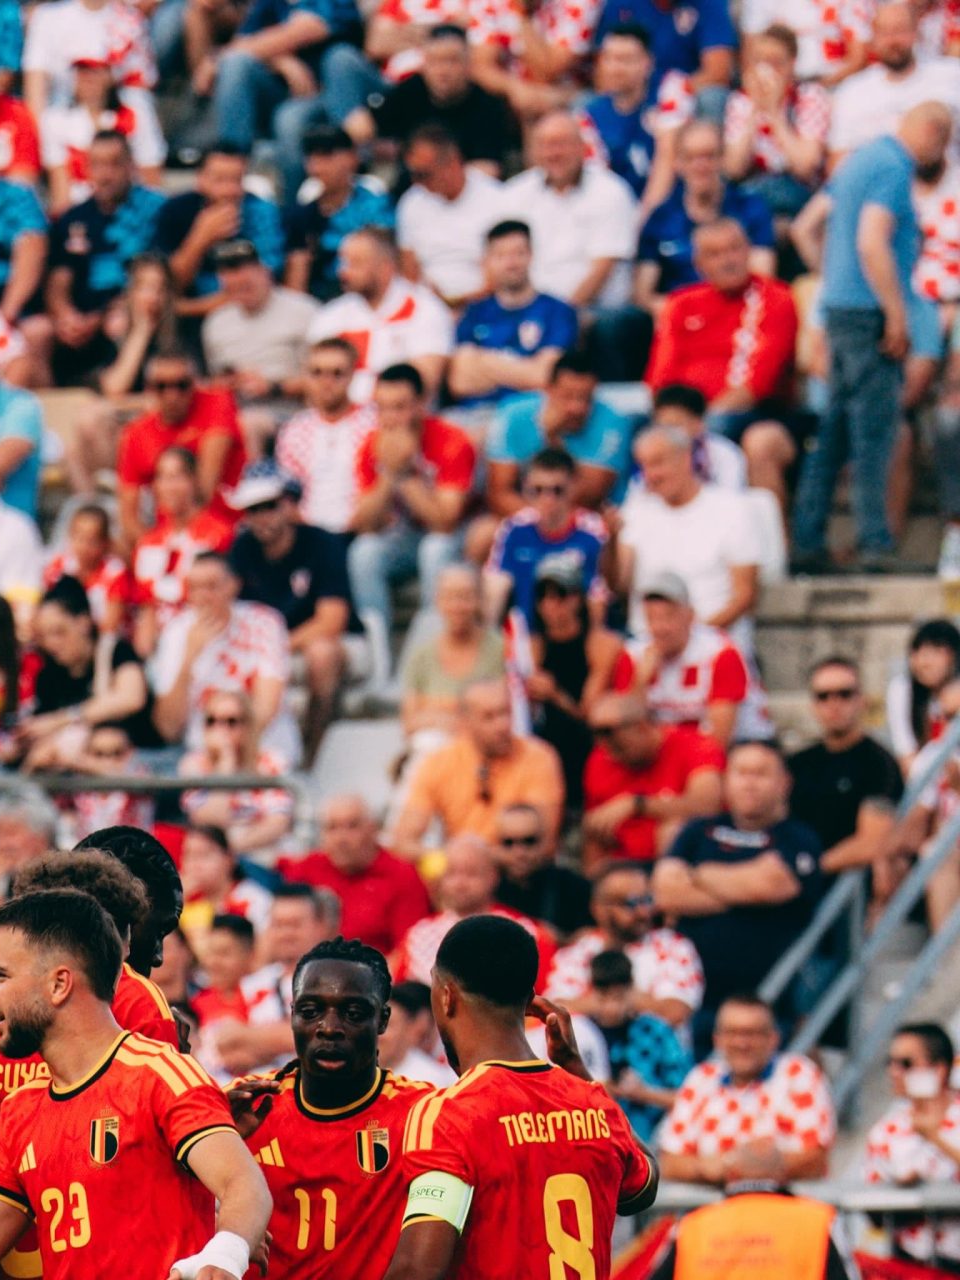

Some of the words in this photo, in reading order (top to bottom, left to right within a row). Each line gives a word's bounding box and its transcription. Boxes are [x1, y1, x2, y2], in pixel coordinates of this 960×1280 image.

[499, 1108, 611, 1147] TIELEMANS
[41, 1181, 91, 1253] 23
[294, 1187, 338, 1251] 11
